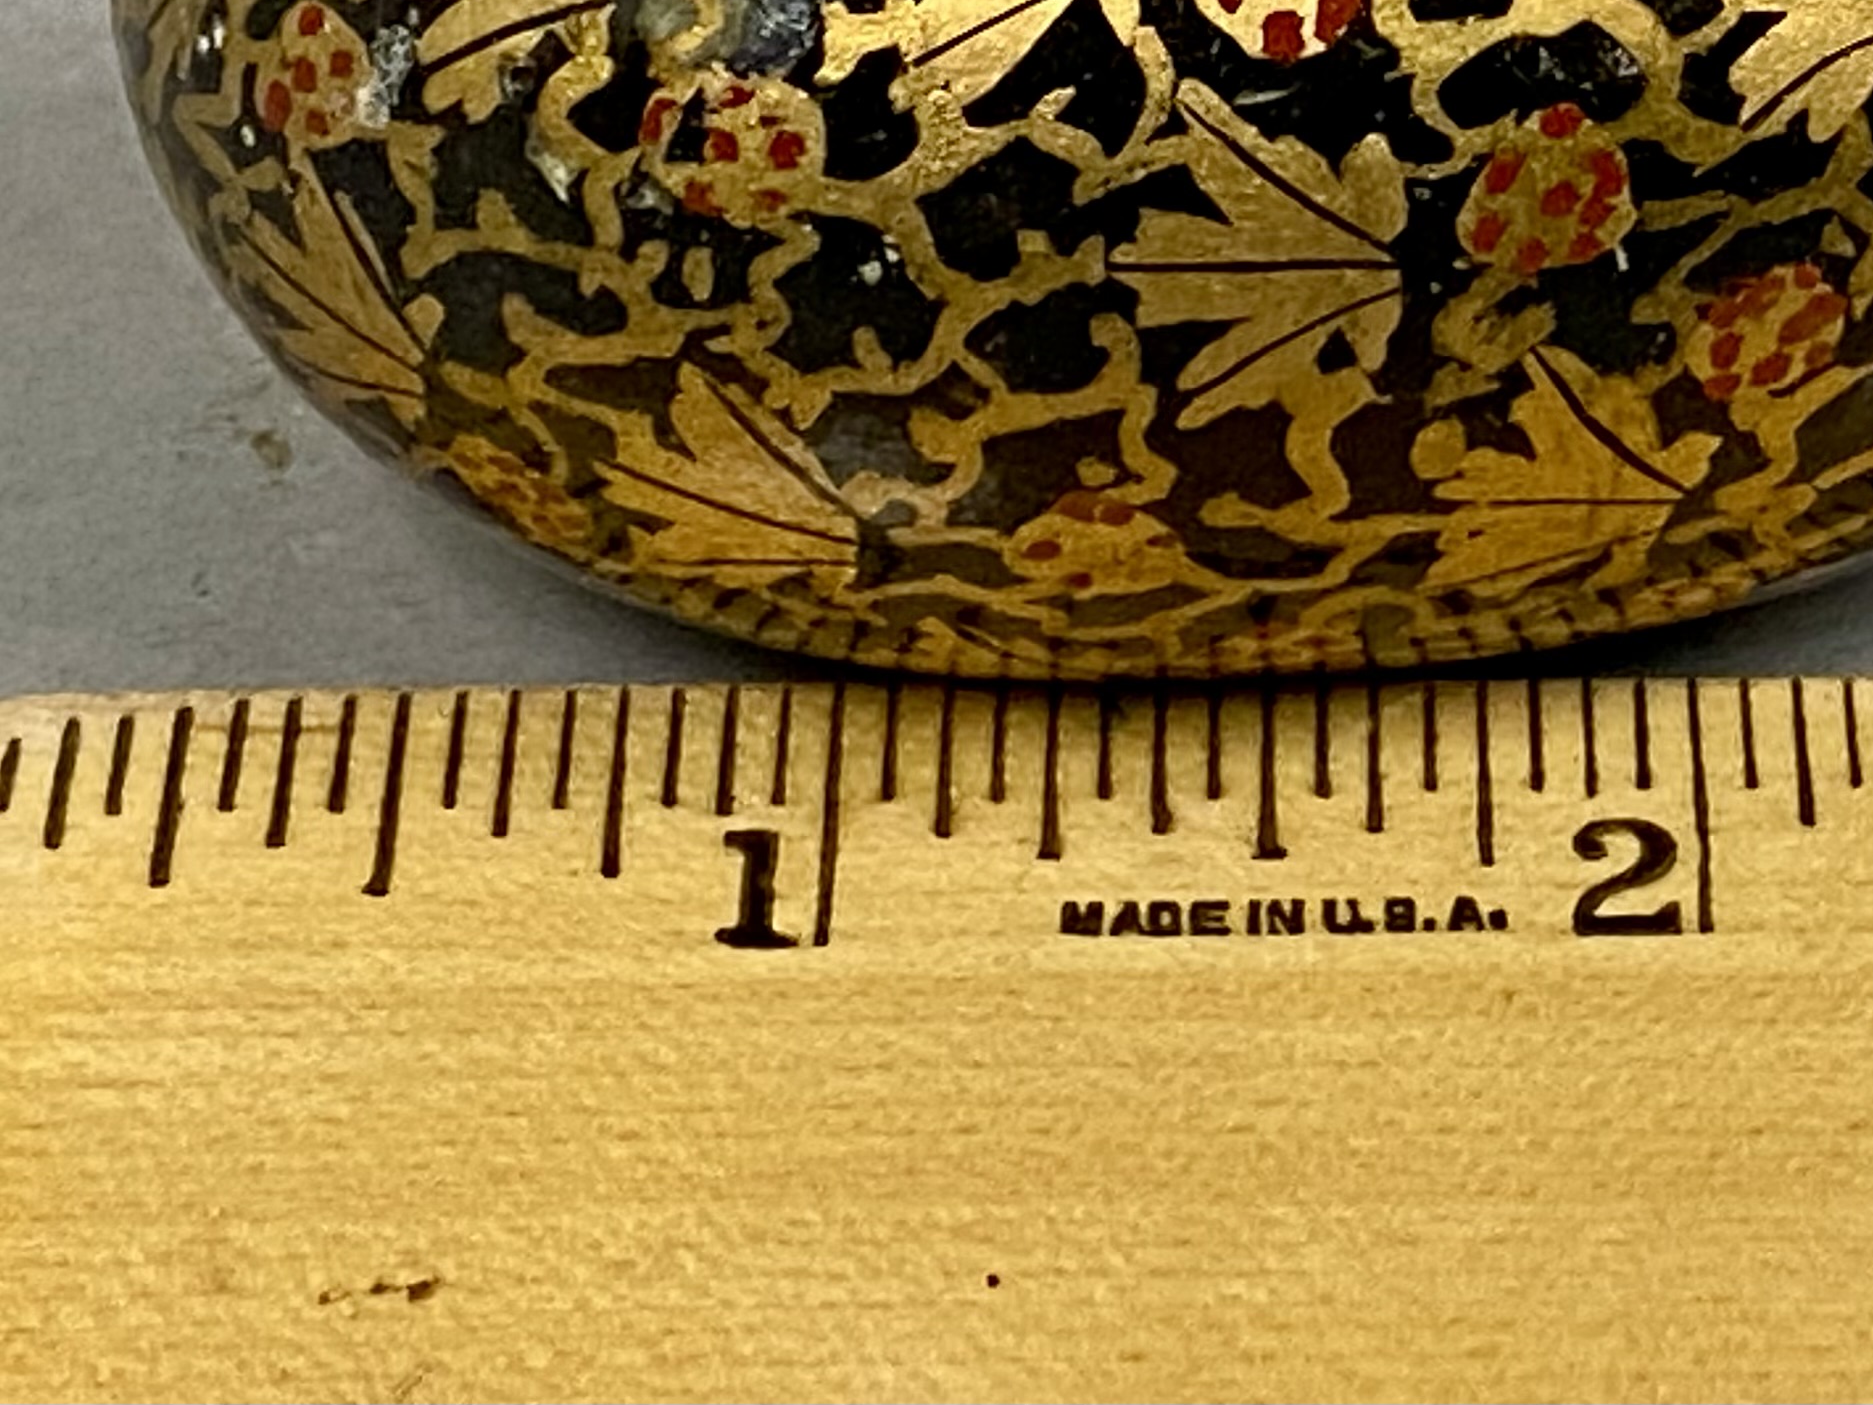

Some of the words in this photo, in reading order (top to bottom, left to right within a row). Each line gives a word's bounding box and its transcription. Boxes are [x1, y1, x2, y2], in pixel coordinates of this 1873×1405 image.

[714, 829, 801, 950] 1
[1059, 900, 1233, 938] MADE
[1245, 899, 1306, 937] IN
[1571, 818, 1684, 937] 2
